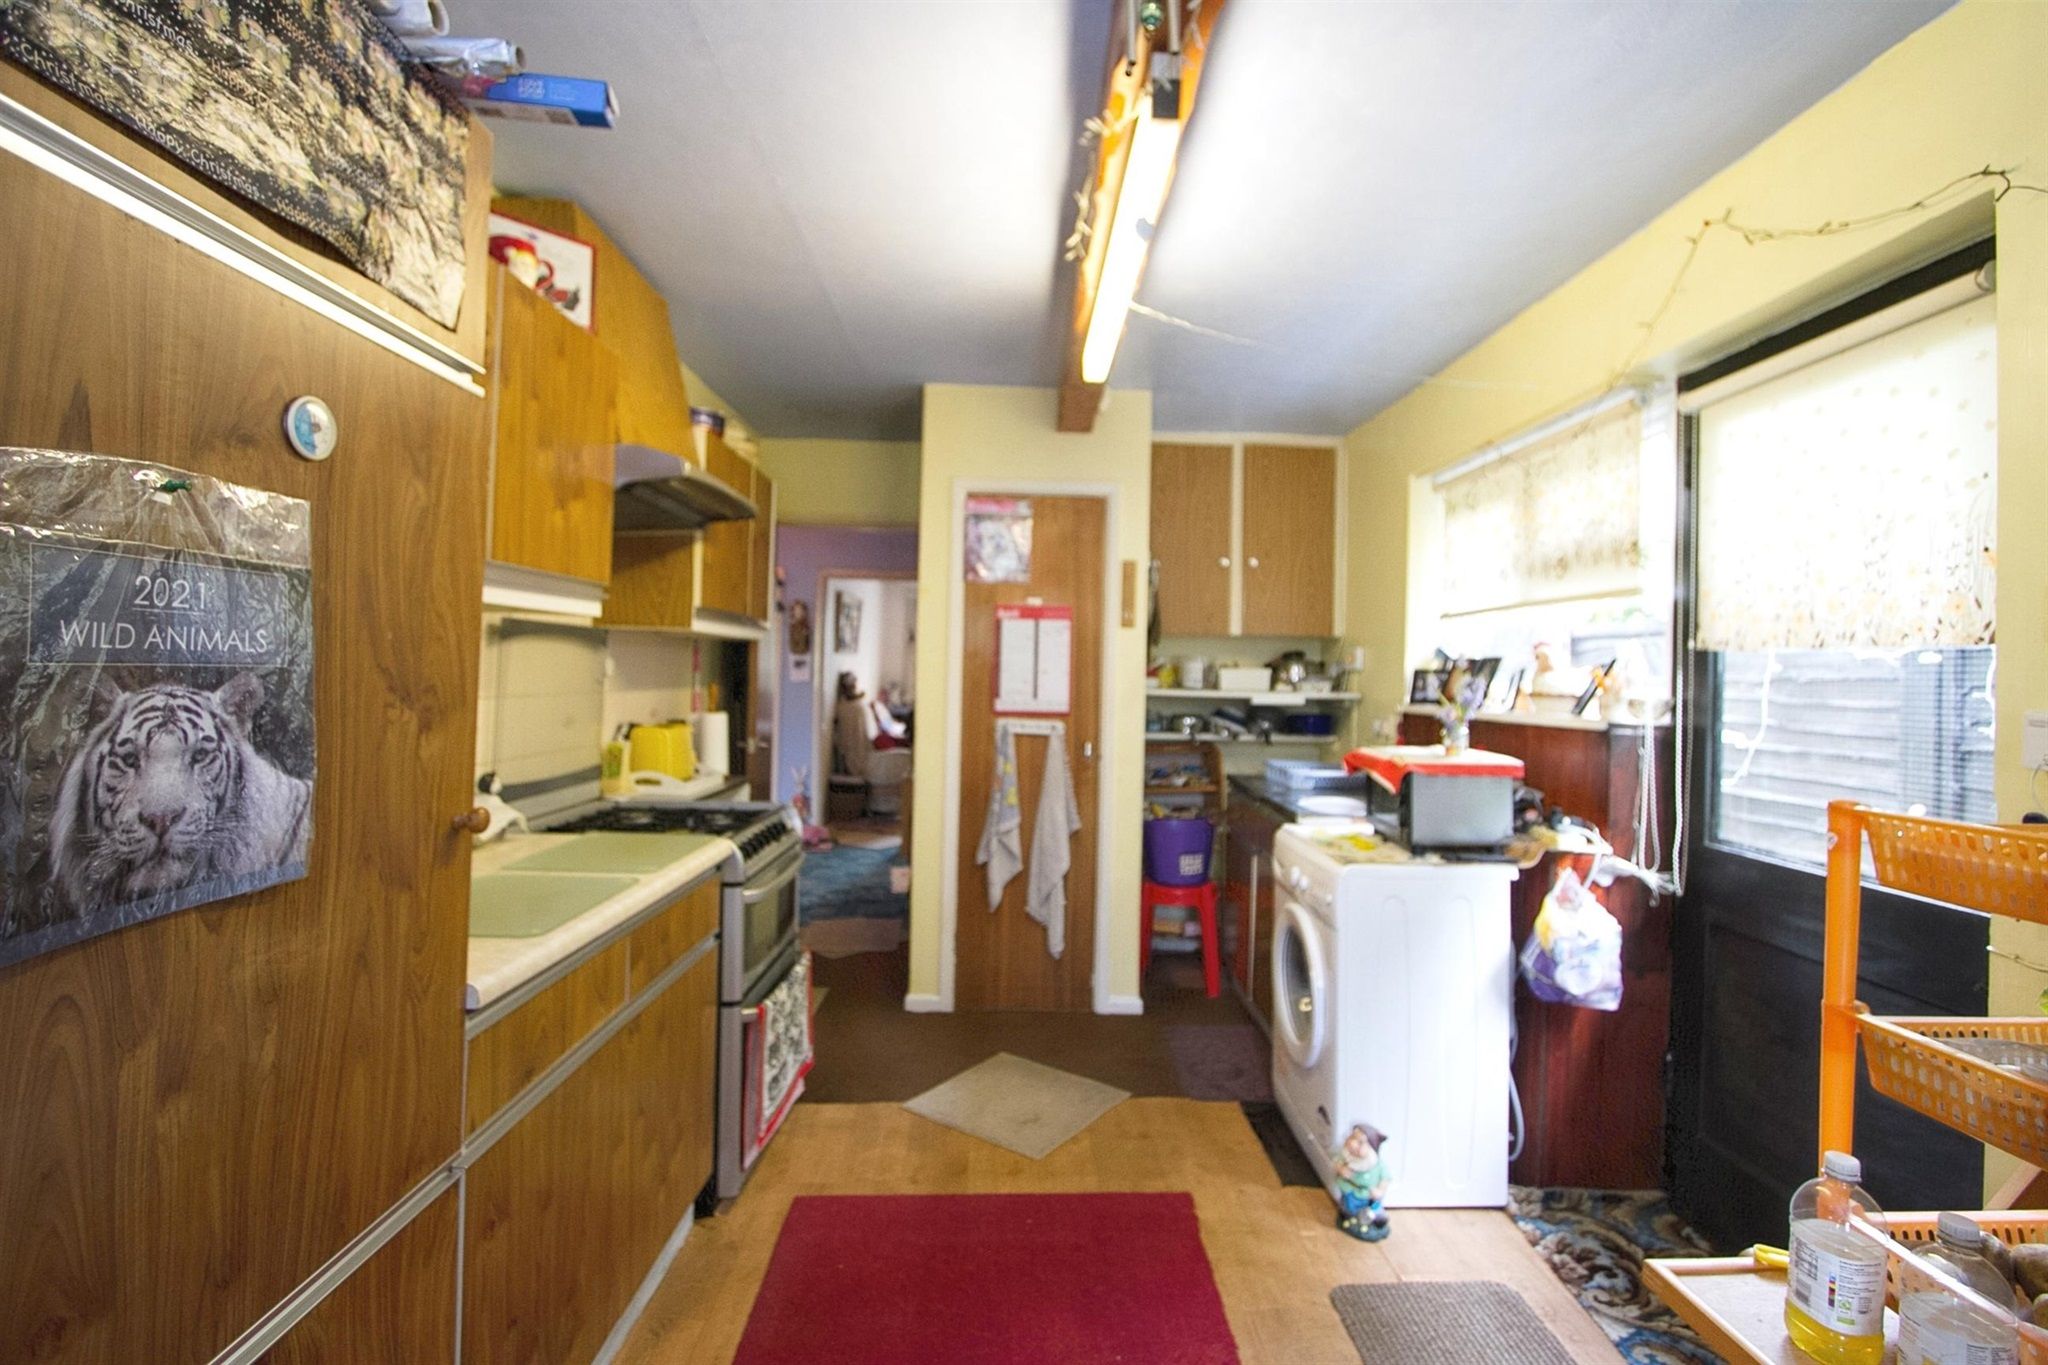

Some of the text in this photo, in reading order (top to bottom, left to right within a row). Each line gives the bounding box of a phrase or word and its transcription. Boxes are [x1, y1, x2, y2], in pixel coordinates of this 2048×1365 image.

[20, 42, 115, 109] Christmas
[136, 117, 261, 198] Happy Christmas
[134, 575, 205, 609] 2021
[60, 619, 268, 653] WILD ANIMALS
